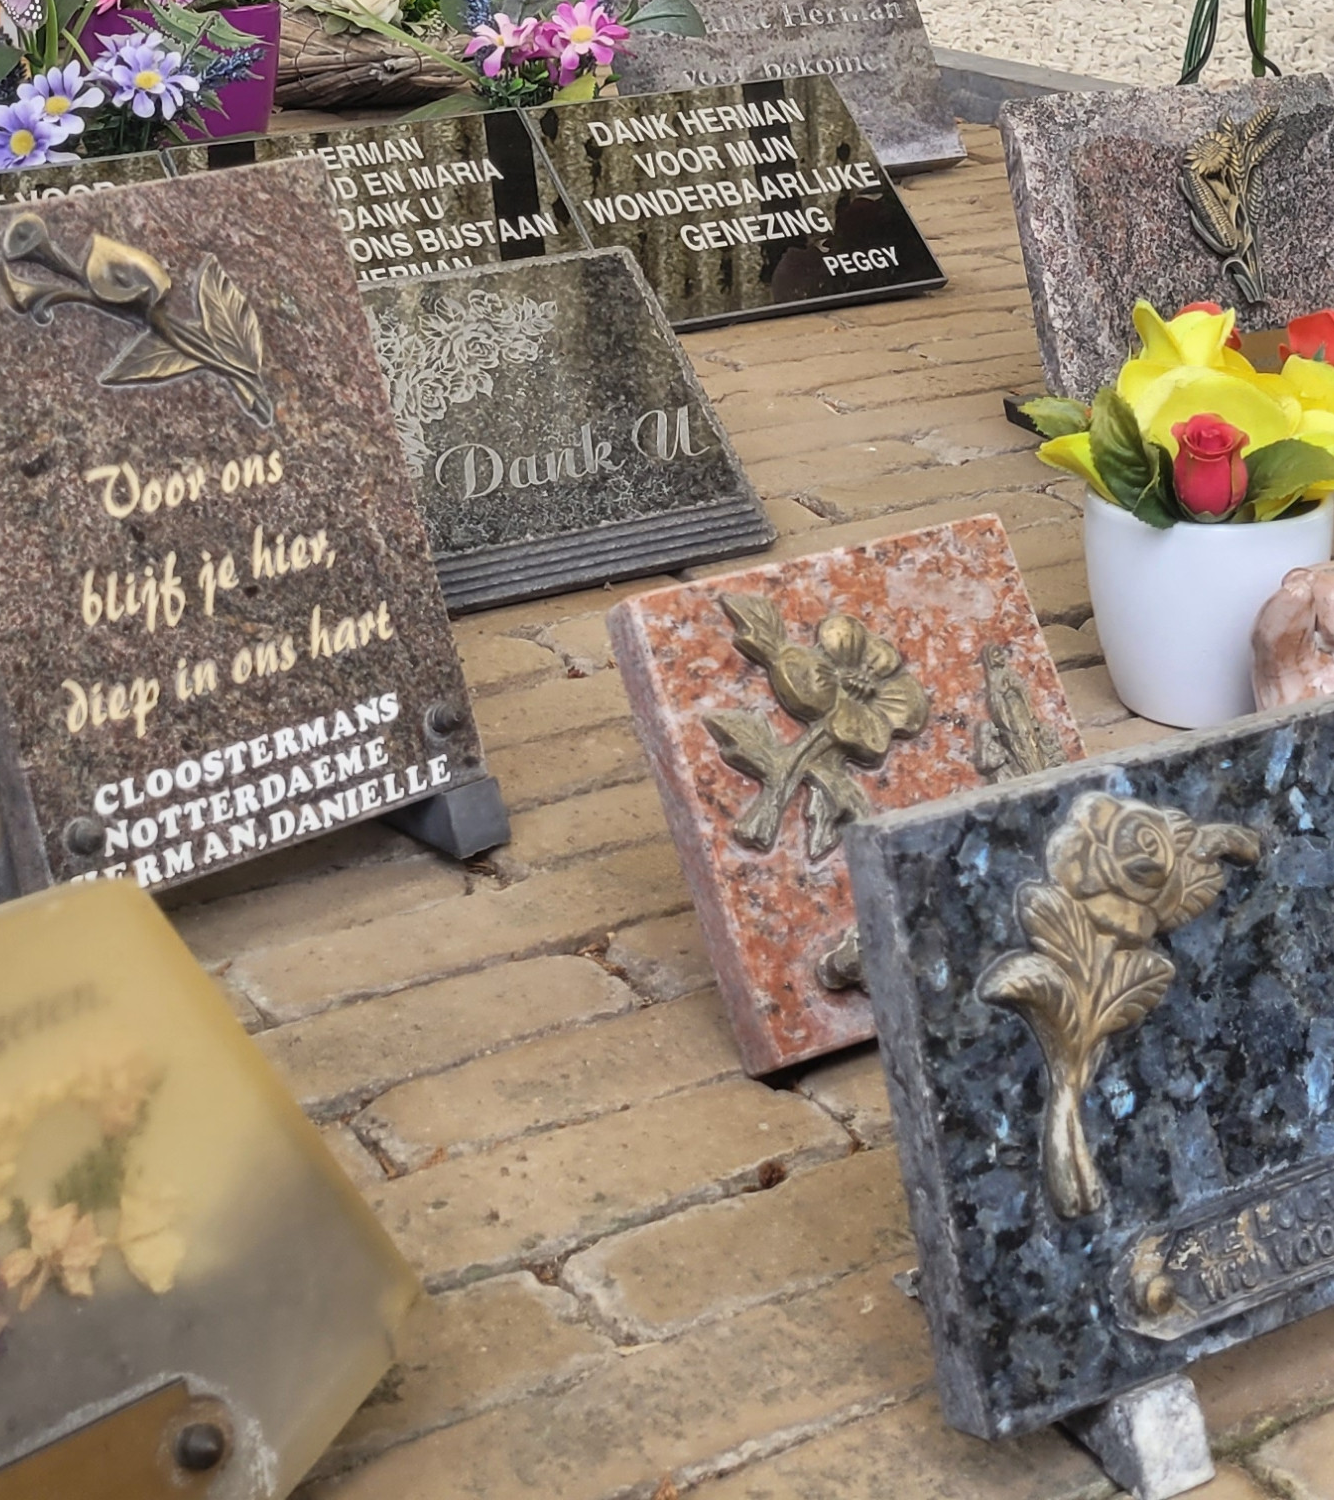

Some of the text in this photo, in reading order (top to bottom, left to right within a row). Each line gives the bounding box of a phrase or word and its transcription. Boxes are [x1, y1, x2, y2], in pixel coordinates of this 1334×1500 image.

[587, 99, 805, 147] DANK HERMAN
[363, 170, 406, 197] EN
[408, 158, 504, 190] MARIA
[633, 136, 799, 179] VOOR MIJN
[338, 196, 445, 232] DANK U
[583, 161, 881, 225] WONDERBAARLIJKE
[348, 212, 559, 263] ONS BIJSTAAN
[679, 206, 834, 251] GENEZING
[823, 246, 899, 277] PEGGY
[435, 405, 711, 500] Dank U
[87, 450, 283, 518] Voor ons
[82, 551, 186, 632] blijf
[199, 551, 239, 617] je
[62, 601, 395, 739] diep in ons hart
[94, 692, 400, 817] CLOOSTERMANS
[104, 736, 390, 857] NOTTERDAEME
